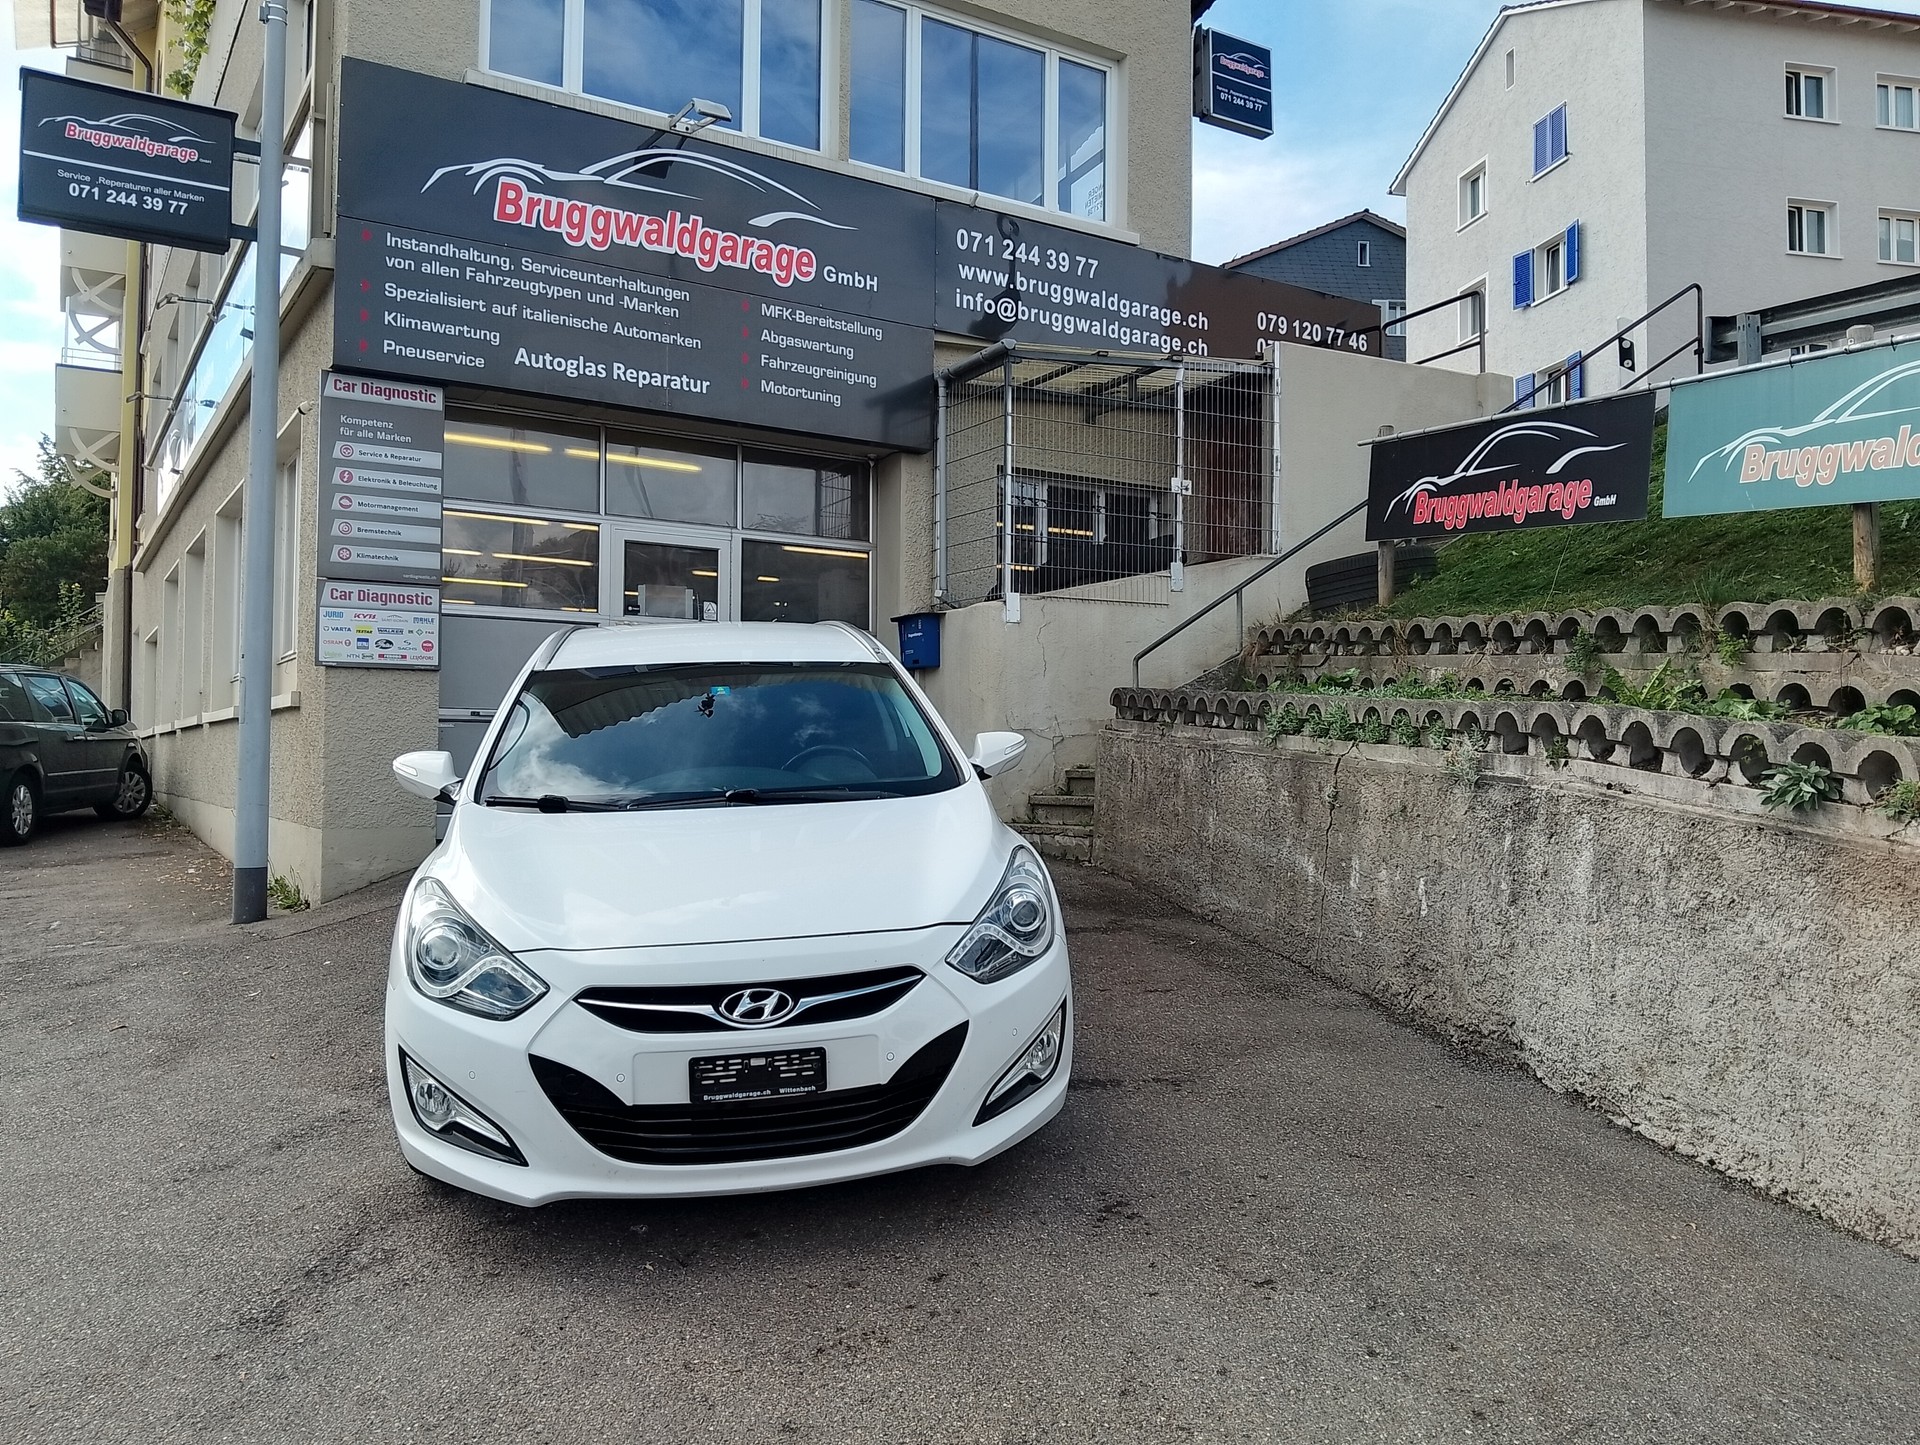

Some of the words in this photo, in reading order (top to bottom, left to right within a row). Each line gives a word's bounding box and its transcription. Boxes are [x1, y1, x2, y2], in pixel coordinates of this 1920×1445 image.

[1220, 92, 1231, 102] 071
[1233, 96, 1244, 106] 244
[1245, 100, 1253, 109] 39
[1254, 103, 1262, 112] 77
[65, 122, 198, 163] Bruggwaldgarage
[57, 168, 91, 182] Service
[153, 186, 172, 197] aller
[173, 189, 205, 202] Marken
[68, 182, 99, 200] 071
[106, 189, 138, 207] 244
[142, 197, 163, 211] 39
[168, 199, 189, 216] 77
[493, 176, 817, 287] Bruggwaldgarage
[823, 265, 878, 292] GmbH
[386, 232, 515, 271] Instandhaltung,
[521, 257, 690, 301] Serviceunterhaltungen
[956, 228, 993, 256] 071
[1002, 239, 1040, 266] 244
[1046, 249, 1070, 273] 39
[1075, 256, 1099, 279] 77
[385, 255, 415, 271] von
[421, 260, 460, 279] allen
[466, 267, 582, 301] Fahrzeugtypen
[587, 289, 614, 307] und
[619, 297, 679, 318] -Marken
[958, 263, 1209, 331] www.bruggwaldgarage.ch
[384, 283, 487, 312] Spezialisiert
[491, 302, 518, 318] auf
[522, 305, 608, 333] italienische
[613, 321, 702, 349] Automarken
[384, 311, 500, 346] Klimawartung
[761, 303, 883, 341] MFK-Bereitstellung
[955, 289, 1208, 356] info@bruggwaldgarage.ch
[1257, 312, 1287, 335] 079
[1293, 319, 1321, 342] 120
[1325, 326, 1345, 347] 77
[1349, 332, 1368, 352] 46
[383, 340, 485, 368] Pneuservice
[761, 329, 854, 360] Abgaswartung
[514, 347, 607, 378] Autoglas
[613, 362, 711, 394] Reparatur
[761, 354, 877, 388] Fahrzeugreinigung
[333, 378, 357, 393] Car
[361, 382, 437, 404] Diagnostic
[761, 380, 841, 407] Motortuning
[340, 414, 394, 429] Kompetenz
[340, 426, 354, 437] für
[357, 429, 374, 439] alle
[376, 431, 412, 443] Marken
[358, 449, 383, 459] Service
[390, 453, 421, 462] Reparatur
[358, 475, 391, 485] Elektronik
[398, 480, 438, 490] Beleuchtung
[357, 500, 418, 512] Motormanagement
[1413, 478, 1593, 530] Bruggwaldgarage
[1594, 494, 1617, 507] GmbH
[357, 527, 402, 537] Bremstechnik
[356, 553, 399, 562] Klimatechnik
[330, 588, 354, 601] Car
[357, 589, 433, 606] Diagnostic
[703, 1089, 771, 1101] Bruggwaldgarage.ch
[779, 1085, 816, 1094] Wittenbach
